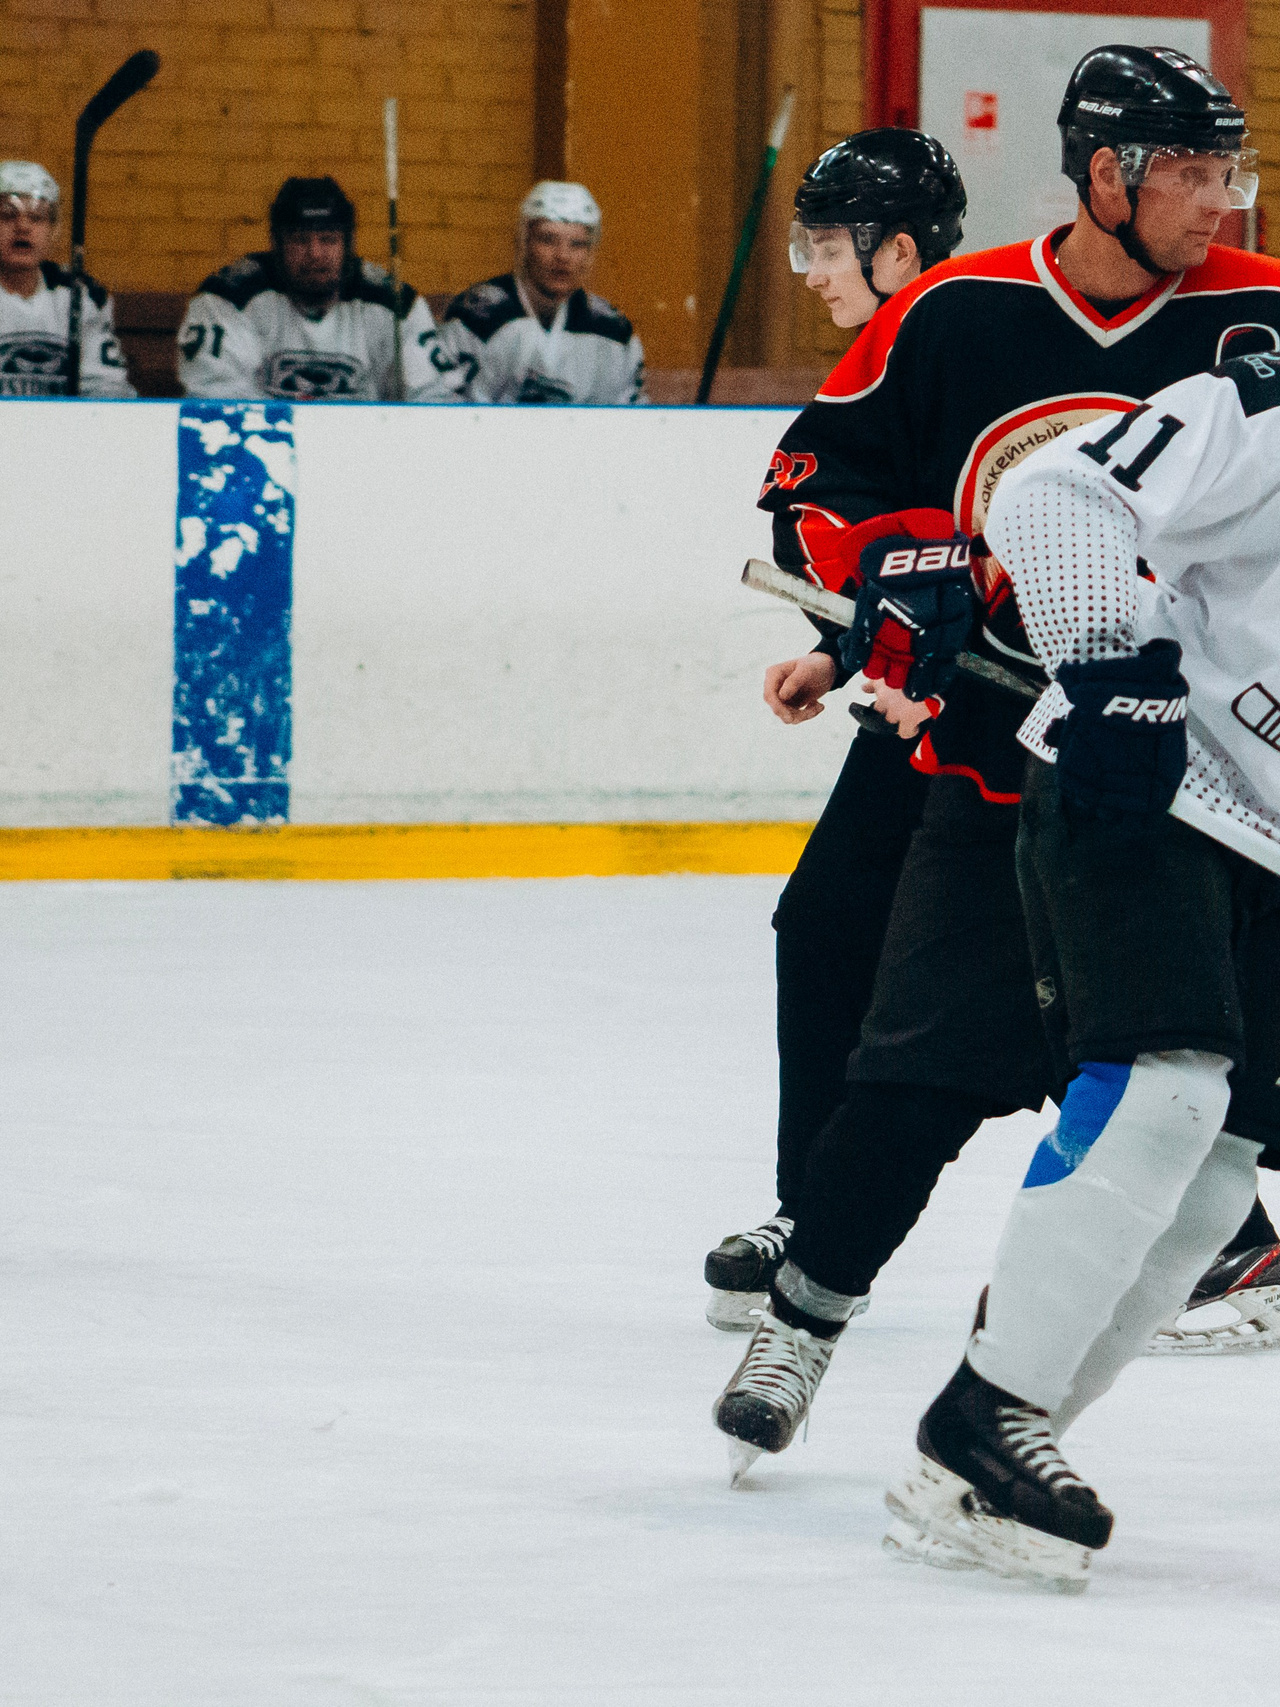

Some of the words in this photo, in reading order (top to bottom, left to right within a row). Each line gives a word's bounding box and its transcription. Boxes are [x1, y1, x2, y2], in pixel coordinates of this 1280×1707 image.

[1077, 100, 1124, 117] BAUER
[1077, 403, 1186, 493] 11
[879, 544, 970, 577] BAU
